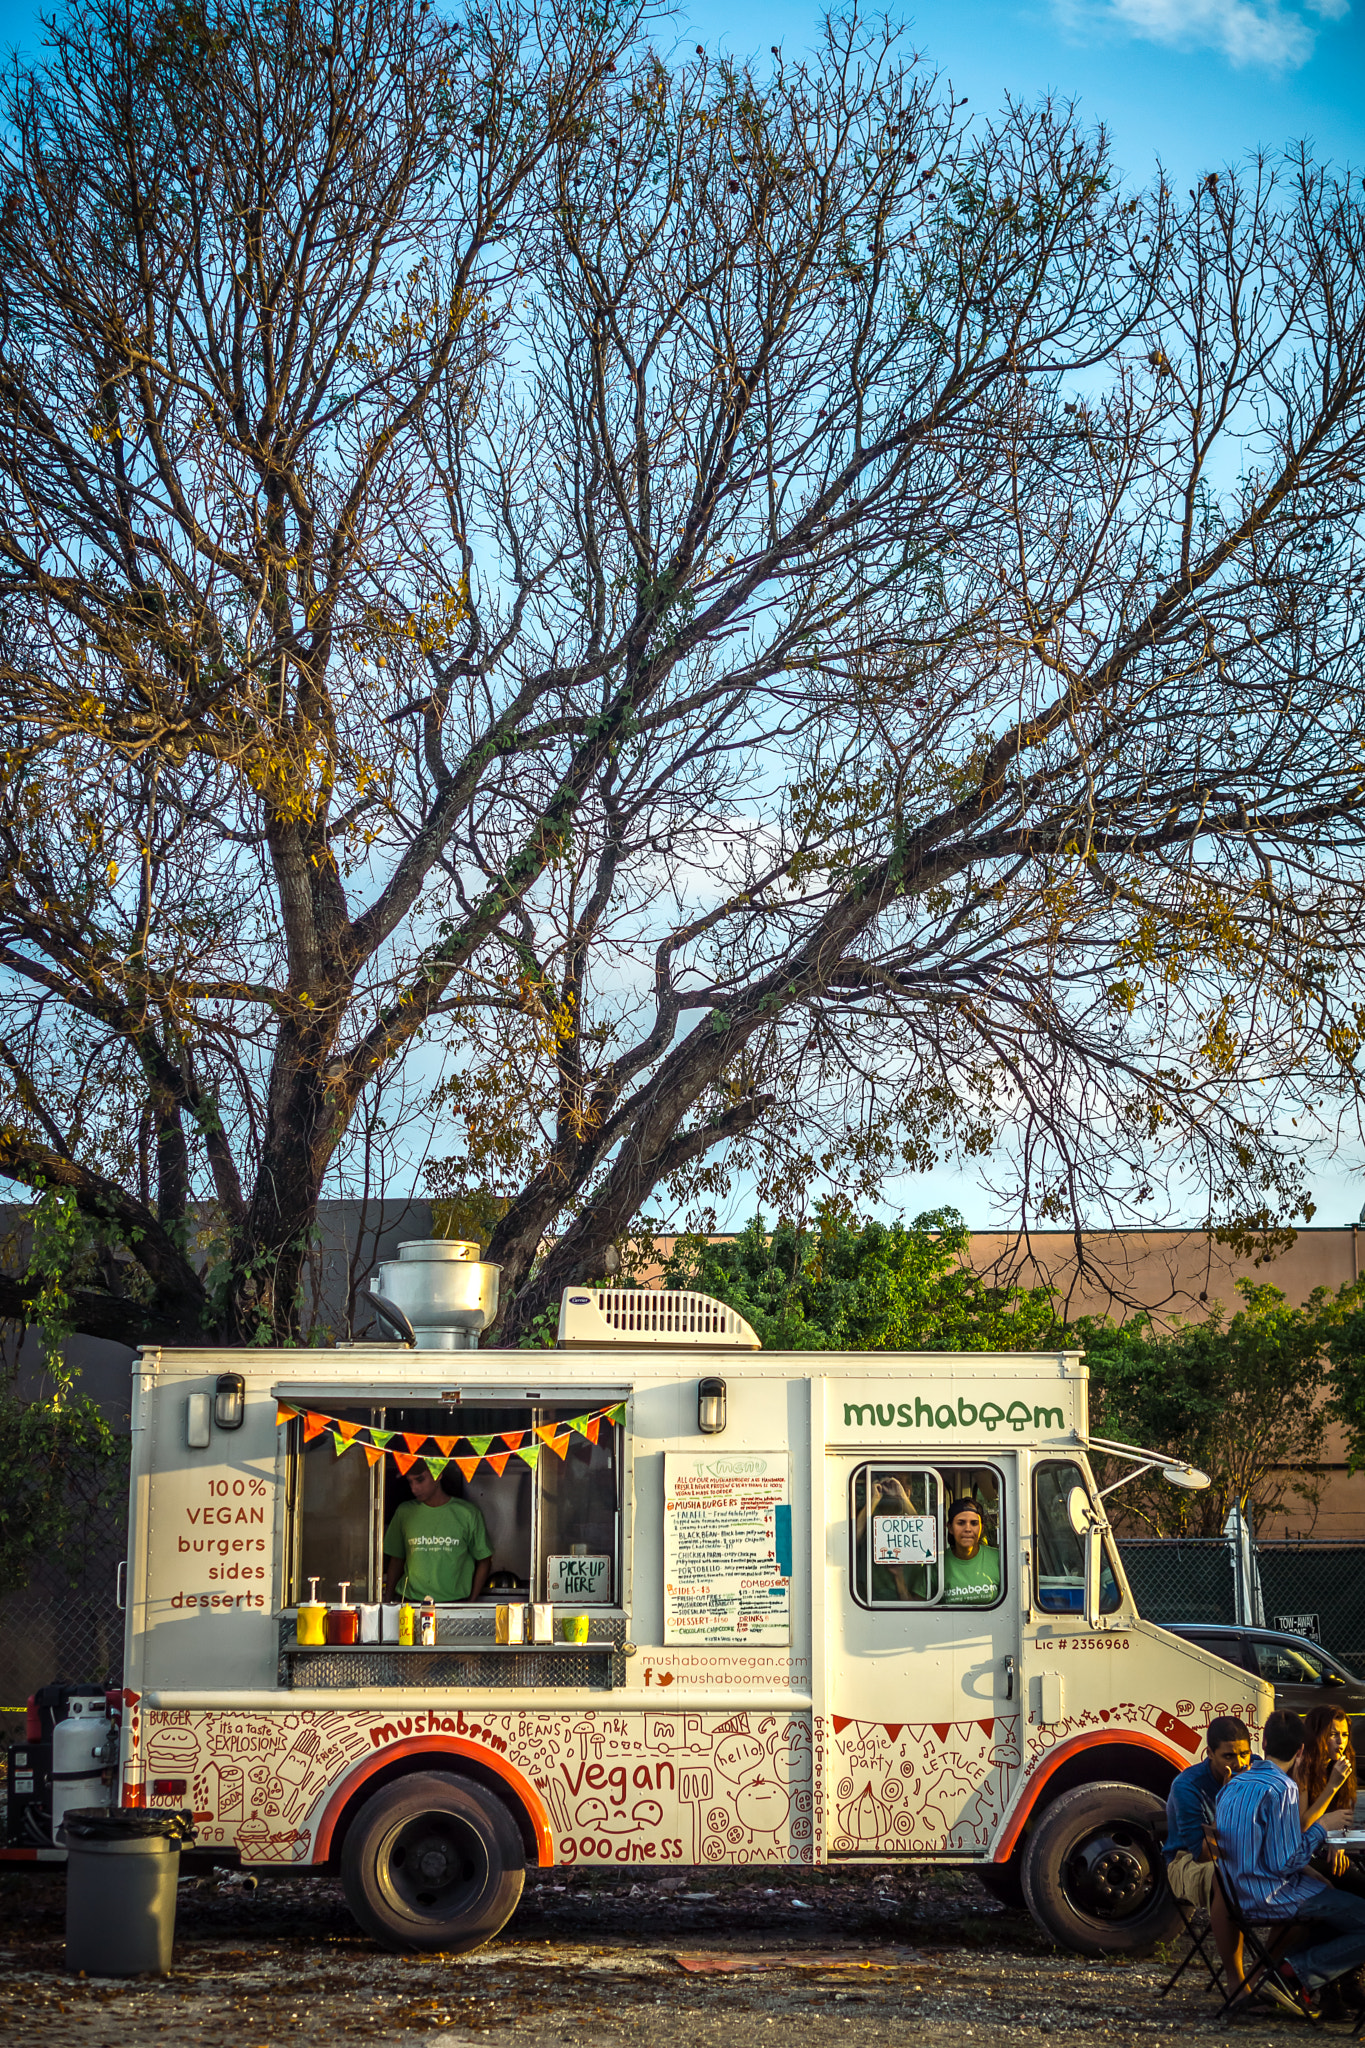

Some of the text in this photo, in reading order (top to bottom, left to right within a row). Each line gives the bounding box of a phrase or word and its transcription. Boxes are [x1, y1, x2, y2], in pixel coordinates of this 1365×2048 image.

[844, 1396, 1064, 1432] mushaboom
[208, 1479, 266, 1497] 100%
[186, 1507, 264, 1524] VEGAN
[882, 1519, 924, 1533] ORDER
[178, 1535, 266, 1556] burgers
[887, 1534, 918, 1548] HERE
[208, 1563, 265, 1580] sides
[560, 1561, 605, 1578] PICK-UP
[678, 1566, 720, 1574] PORTOBELLO
[565, 1576, 596, 1594] HERE
[170, 1592, 265, 1608] desserts
[1279, 1616, 1314, 1629] TOW-AWAY
[1058, 1639, 1068, 1650] #
[1072, 1639, 1130, 1650] 2356968
[677, 1673, 808, 1687] mushaboomvegan
[150, 1710, 192, 1726] BURGER
[220, 1720, 272, 1736] it's a taste
[370, 1710, 507, 1753] mushaboom
[519, 1721, 560, 1737] BEANS
[1027, 1716, 1080, 1756] BOOM
[215, 1735, 281, 1752] EXPLOSION!
[716, 1744, 762, 1766] hello!
[922, 1752, 985, 1779] LETTUCE
[150, 1795, 183, 1807] BOOM
[220, 1791, 243, 1810] SODA
[560, 1836, 682, 1865] goodness
[726, 1845, 799, 1865] TOMATO
[884, 1839, 937, 1856] ONION
